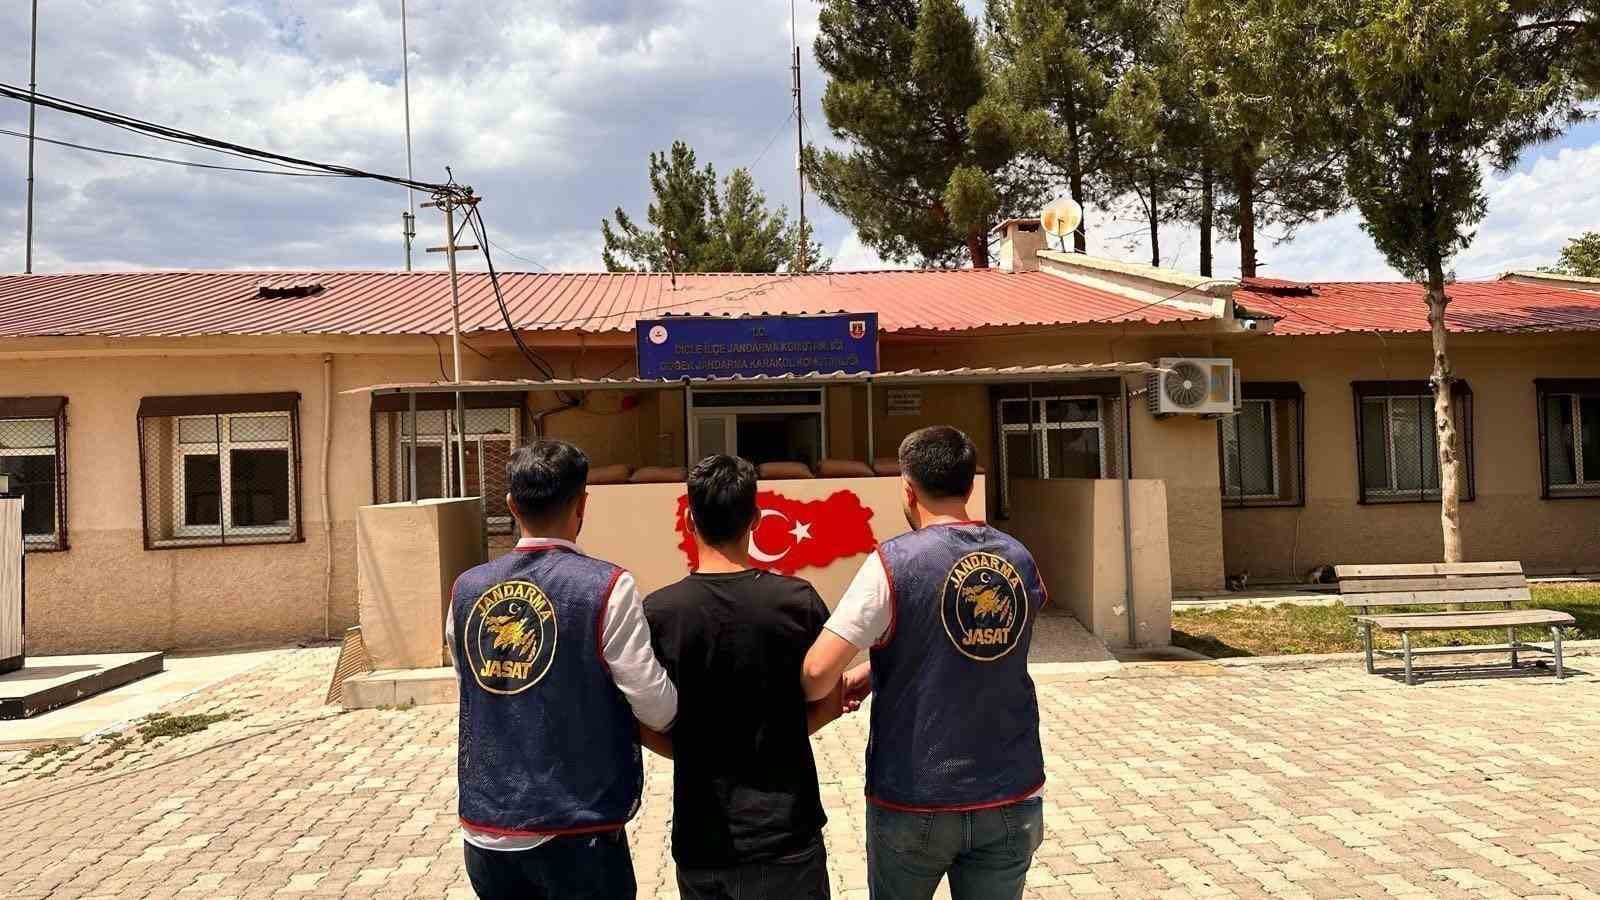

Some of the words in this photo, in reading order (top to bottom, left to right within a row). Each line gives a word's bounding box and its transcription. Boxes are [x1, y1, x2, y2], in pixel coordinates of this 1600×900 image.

[728, 342, 781, 354] JANDARMA
[950, 555, 1019, 589] JANDARMA
[477, 584, 553, 621] JANDARMA
[962, 628, 1010, 645] JASAT
[480, 660, 532, 679] JASAT
